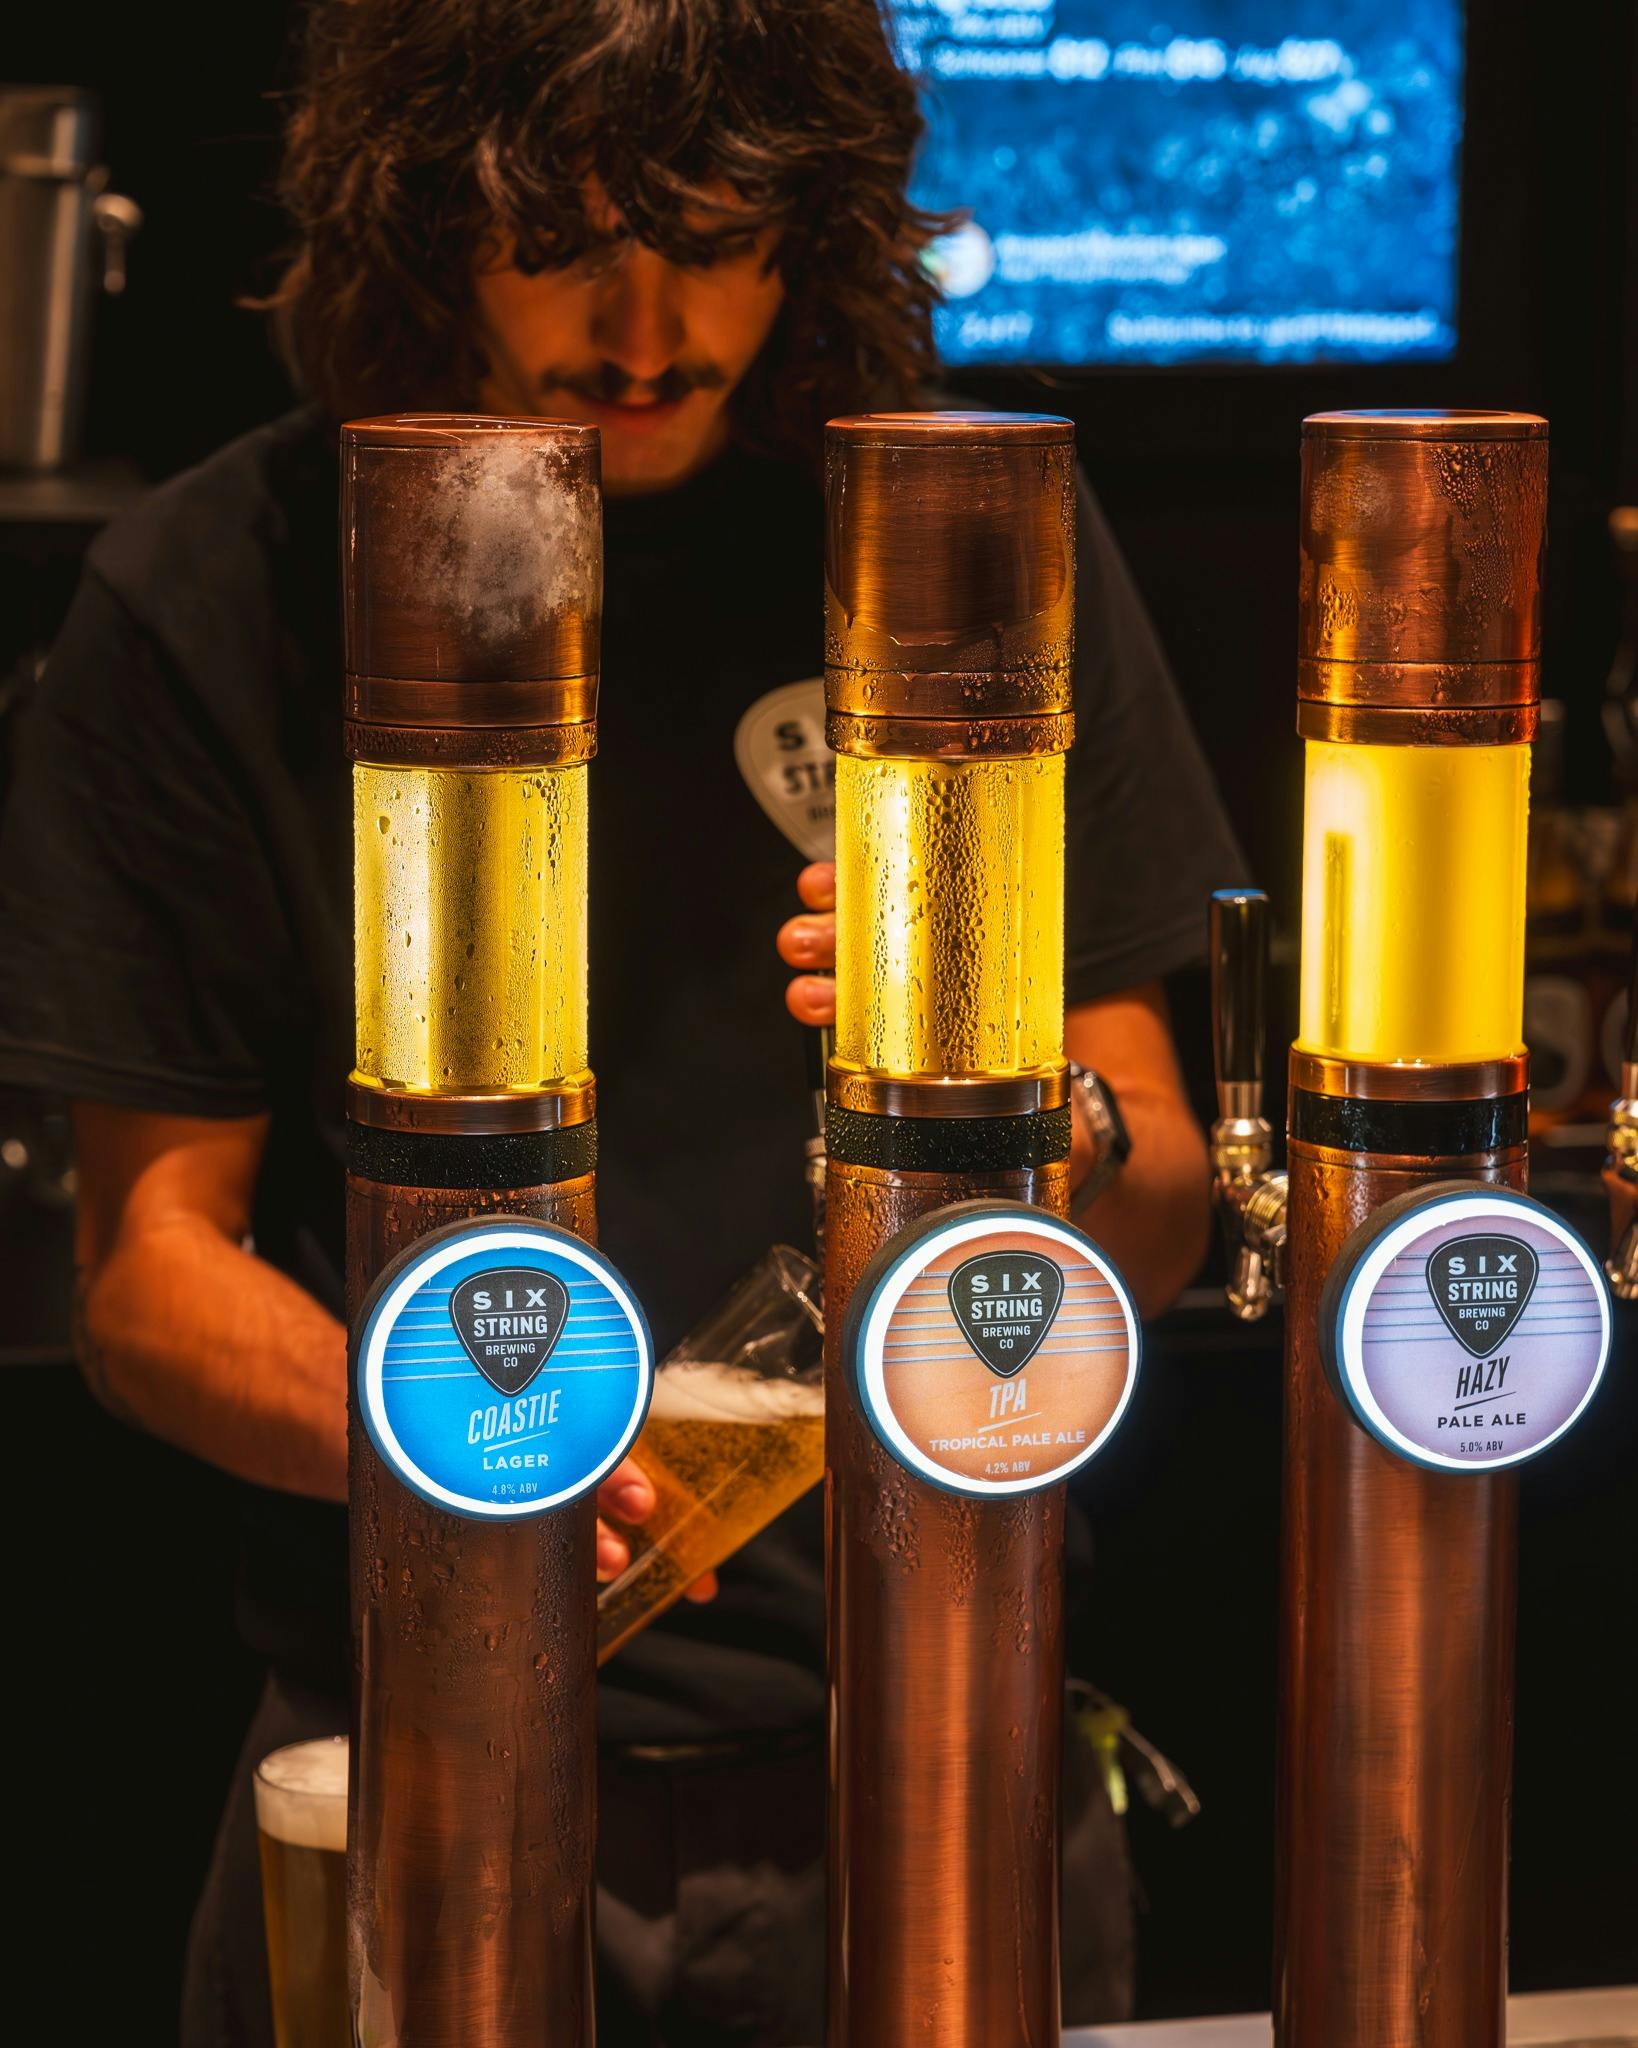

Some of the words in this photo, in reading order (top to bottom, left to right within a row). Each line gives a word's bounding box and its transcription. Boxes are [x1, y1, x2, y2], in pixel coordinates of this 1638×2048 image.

[1448, 1254, 1518, 1275] SIX
[971, 1272, 1042, 1293] SIX
[1448, 1280, 1518, 1301] STRING
[473, 1288, 547, 1310] SIX
[971, 1298, 1043, 1320] STRING
[1459, 1307, 1506, 1319] BREWING
[474, 1315, 548, 1337] STRING
[982, 1325, 1031, 1338] BREWING
[1475, 1319, 1489, 1331] CO
[485, 1342, 536, 1356] BREWING
[999, 1338, 1014, 1350] CO
[503, 1356, 518, 1368] CO
[1455, 1355, 1511, 1399] HAZY
[988, 1378, 1027, 1419] TPA
[467, 1388, 562, 1445] COASTIE
[1437, 1415, 1484, 1429] PALE
[1491, 1413, 1526, 1426] ALE
[929, 1433, 1007, 1452] TROPICAL
[1012, 1431, 1050, 1447] PALE
[1055, 1430, 1085, 1444] ALE
[1460, 1441, 1483, 1453] 5.0%
[1486, 1440, 1504, 1452] ABV
[483, 1454, 549, 1470] LAGER
[985, 1462, 1008, 1474] 4.2%
[1012, 1461, 1031, 1472] ABV
[492, 1484, 516, 1495] 4.8%
[519, 1482, 538, 1494] ABV
